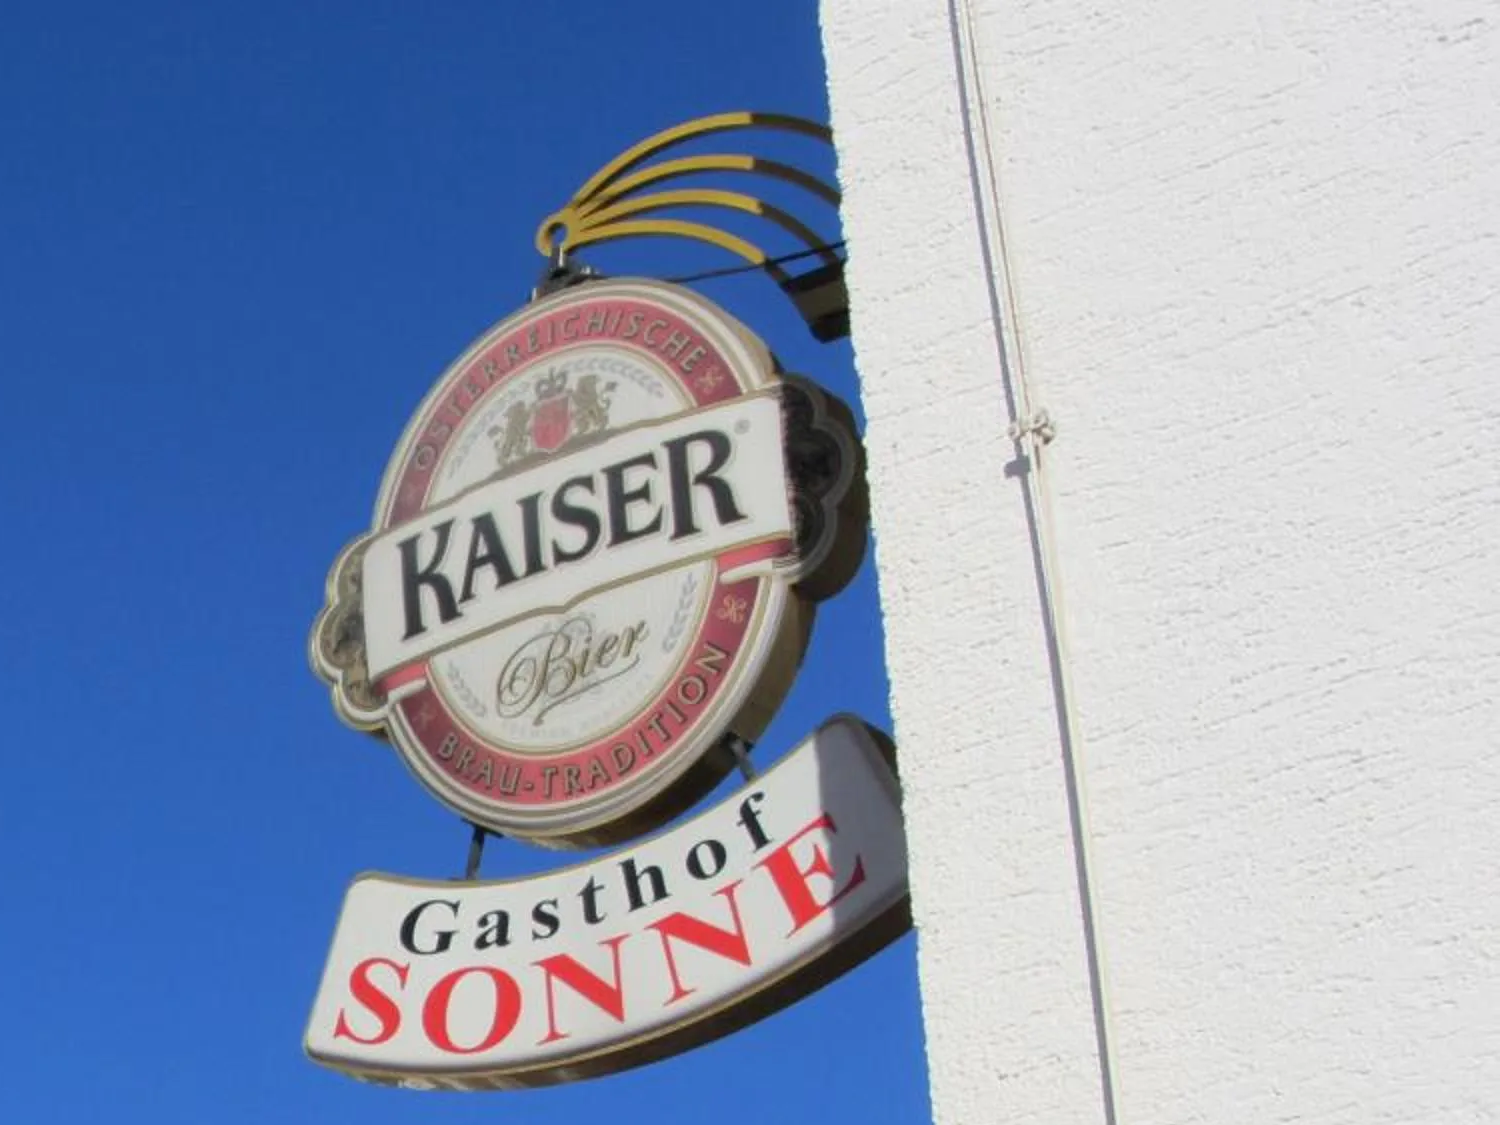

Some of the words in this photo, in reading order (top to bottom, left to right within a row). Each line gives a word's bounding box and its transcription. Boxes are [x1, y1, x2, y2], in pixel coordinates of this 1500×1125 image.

[396, 429, 747, 640] KAISER
[496, 616, 650, 727] Bier
[333, 812, 866, 1055] SONNE
[399, 792, 773, 955] Gasthof
